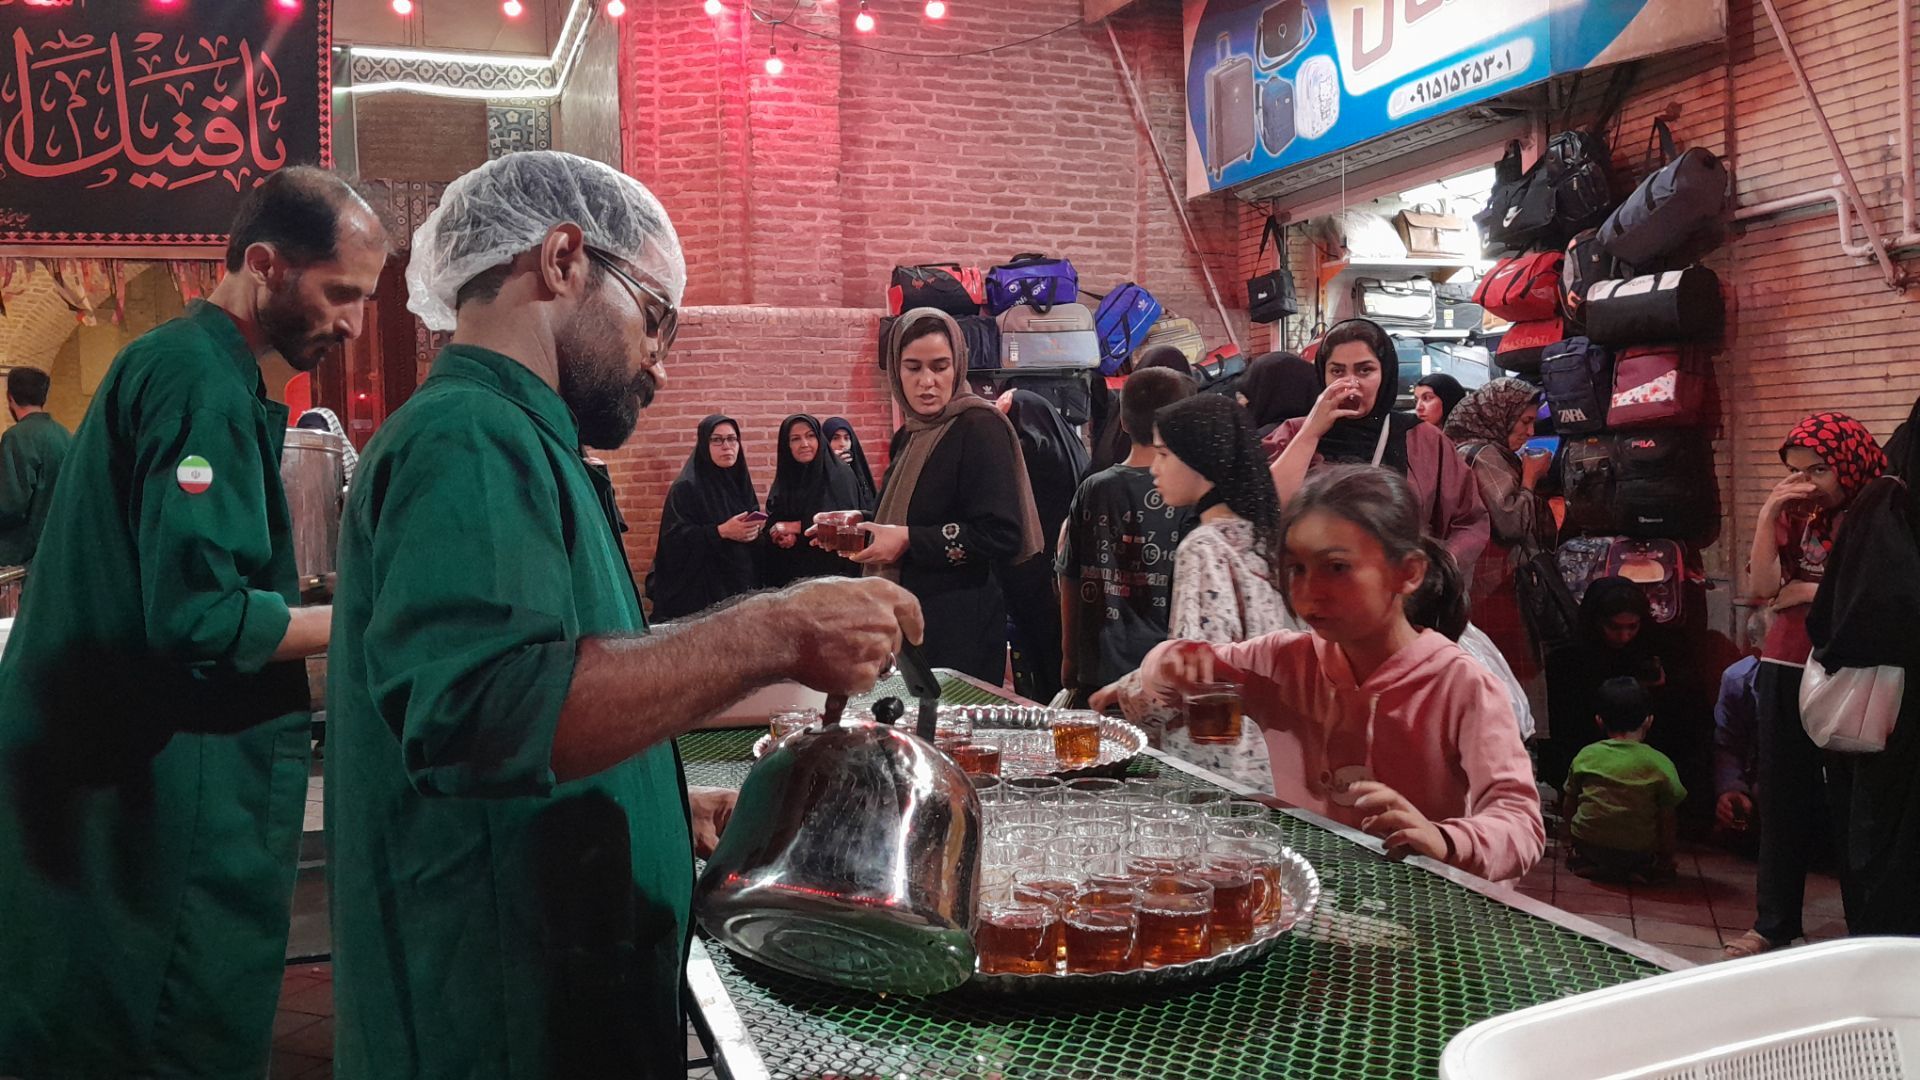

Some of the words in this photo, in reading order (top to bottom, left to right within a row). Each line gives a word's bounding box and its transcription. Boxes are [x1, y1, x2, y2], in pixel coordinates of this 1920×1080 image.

[1409, 48, 1513, 104] ۰۹۱۵۱۵۴۵۳۰۱
[1557, 407, 1588, 423] ZARA
[1122, 510, 1132, 523] 4
[1137, 511, 1144, 522] 5
[1164, 506, 1175, 519] 8
[1147, 530, 1157, 542] 7
[1171, 531, 1179, 542] 9
[1153, 597, 1166, 607] 23
[1106, 607, 1119, 619] 20
